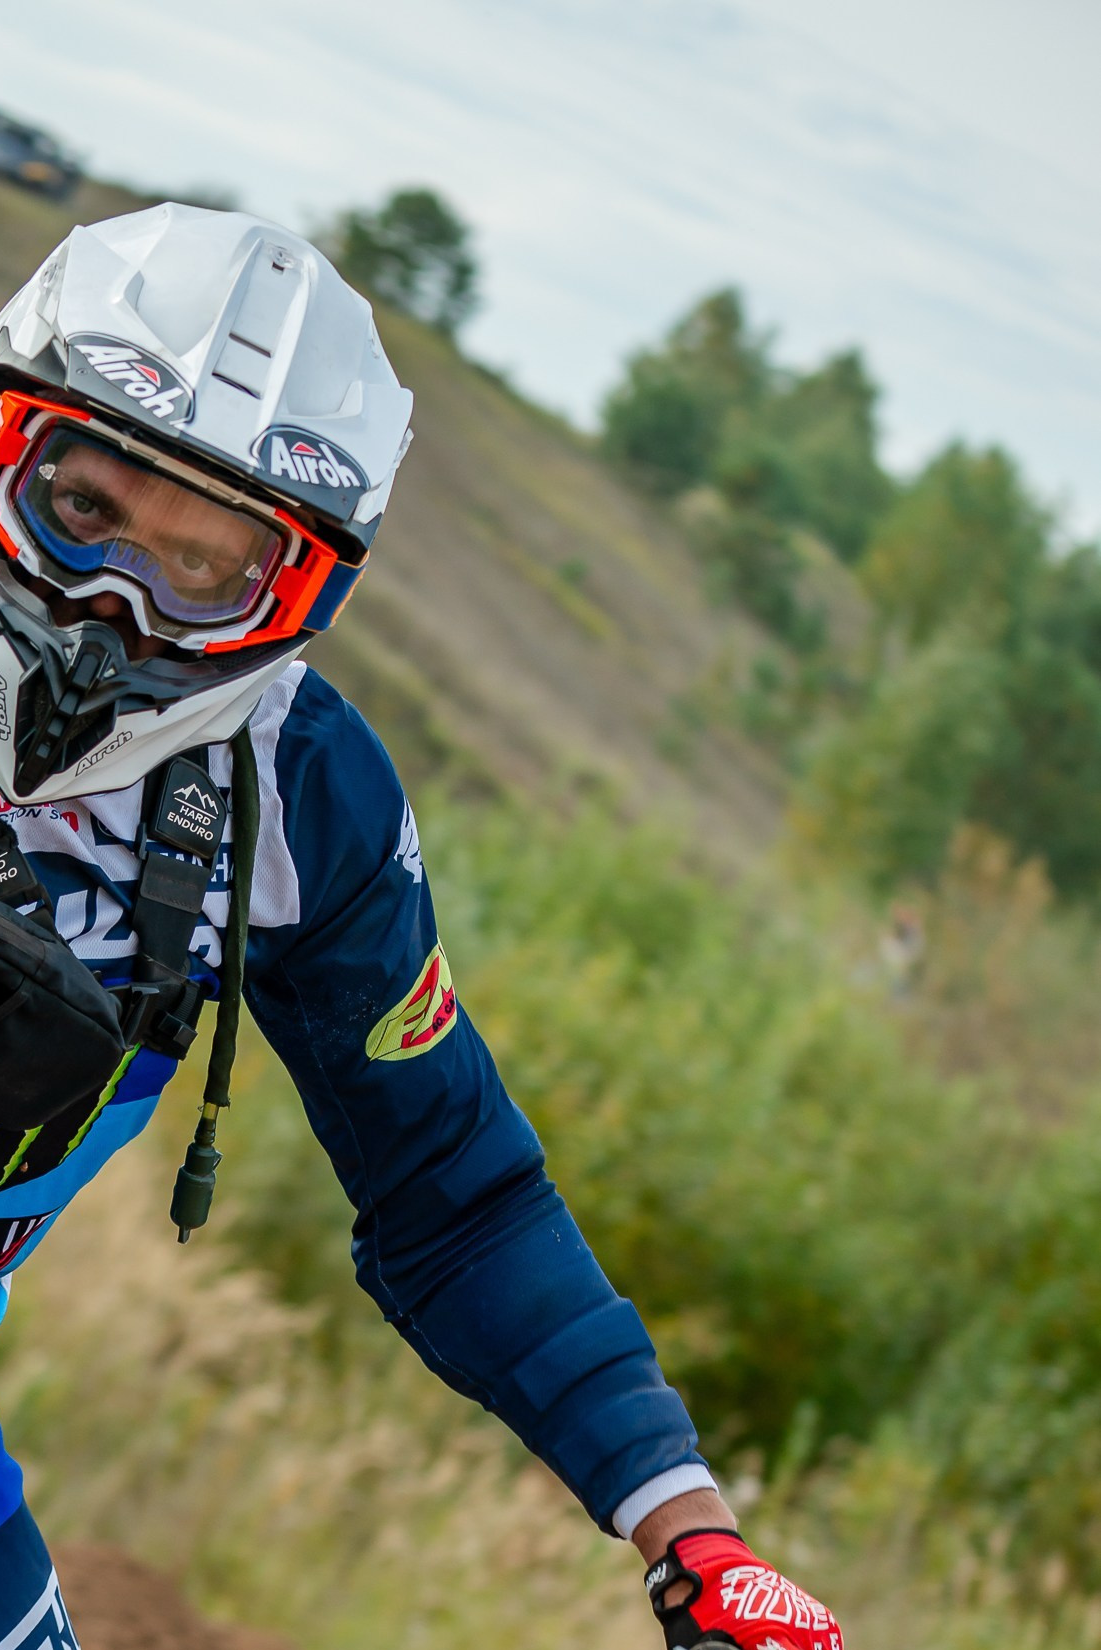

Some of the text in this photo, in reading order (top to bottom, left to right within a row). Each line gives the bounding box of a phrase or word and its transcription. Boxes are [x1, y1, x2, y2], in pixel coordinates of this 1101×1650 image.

[73, 344, 184, 419] Airoh
[270, 435, 361, 489] Airoh
[74, 730, 134, 778] Airoh
[166, 811, 214, 842] ENDURO
[178, 804, 212, 827] HARD
